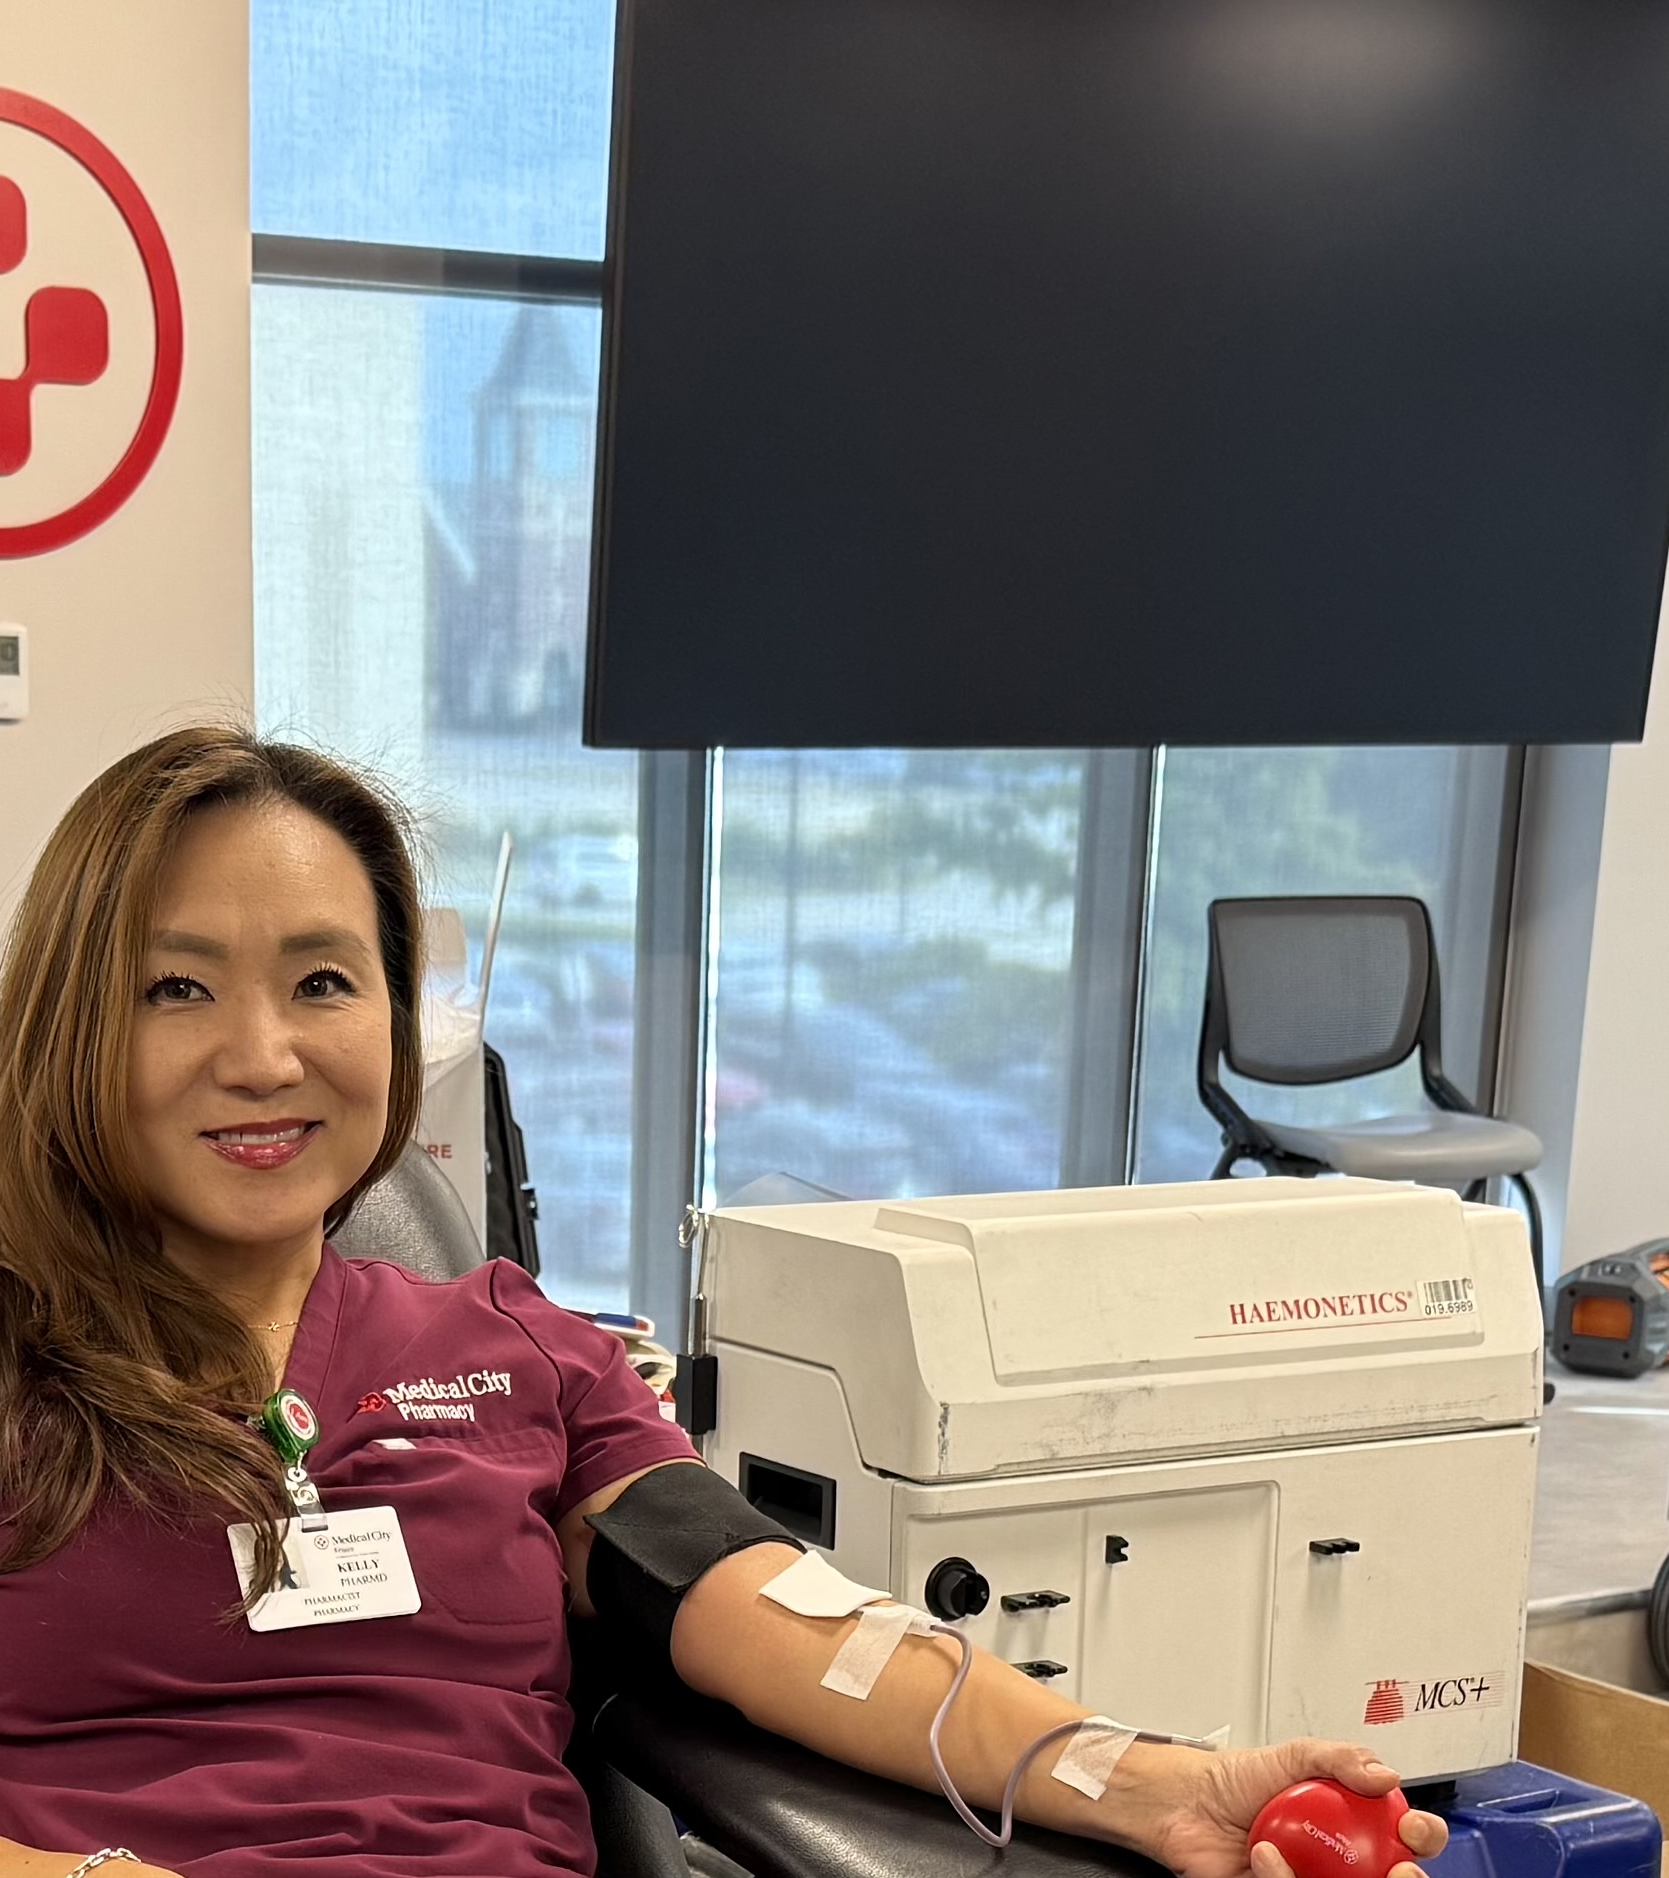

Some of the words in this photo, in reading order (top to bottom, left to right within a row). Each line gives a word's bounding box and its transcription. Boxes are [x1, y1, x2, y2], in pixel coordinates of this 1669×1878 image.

[383, 1375, 471, 1404] Medical
[467, 1369, 512, 1396] City
[396, 1402, 476, 1423] Pharmacy
[337, 1559, 379, 1574] KELLY
